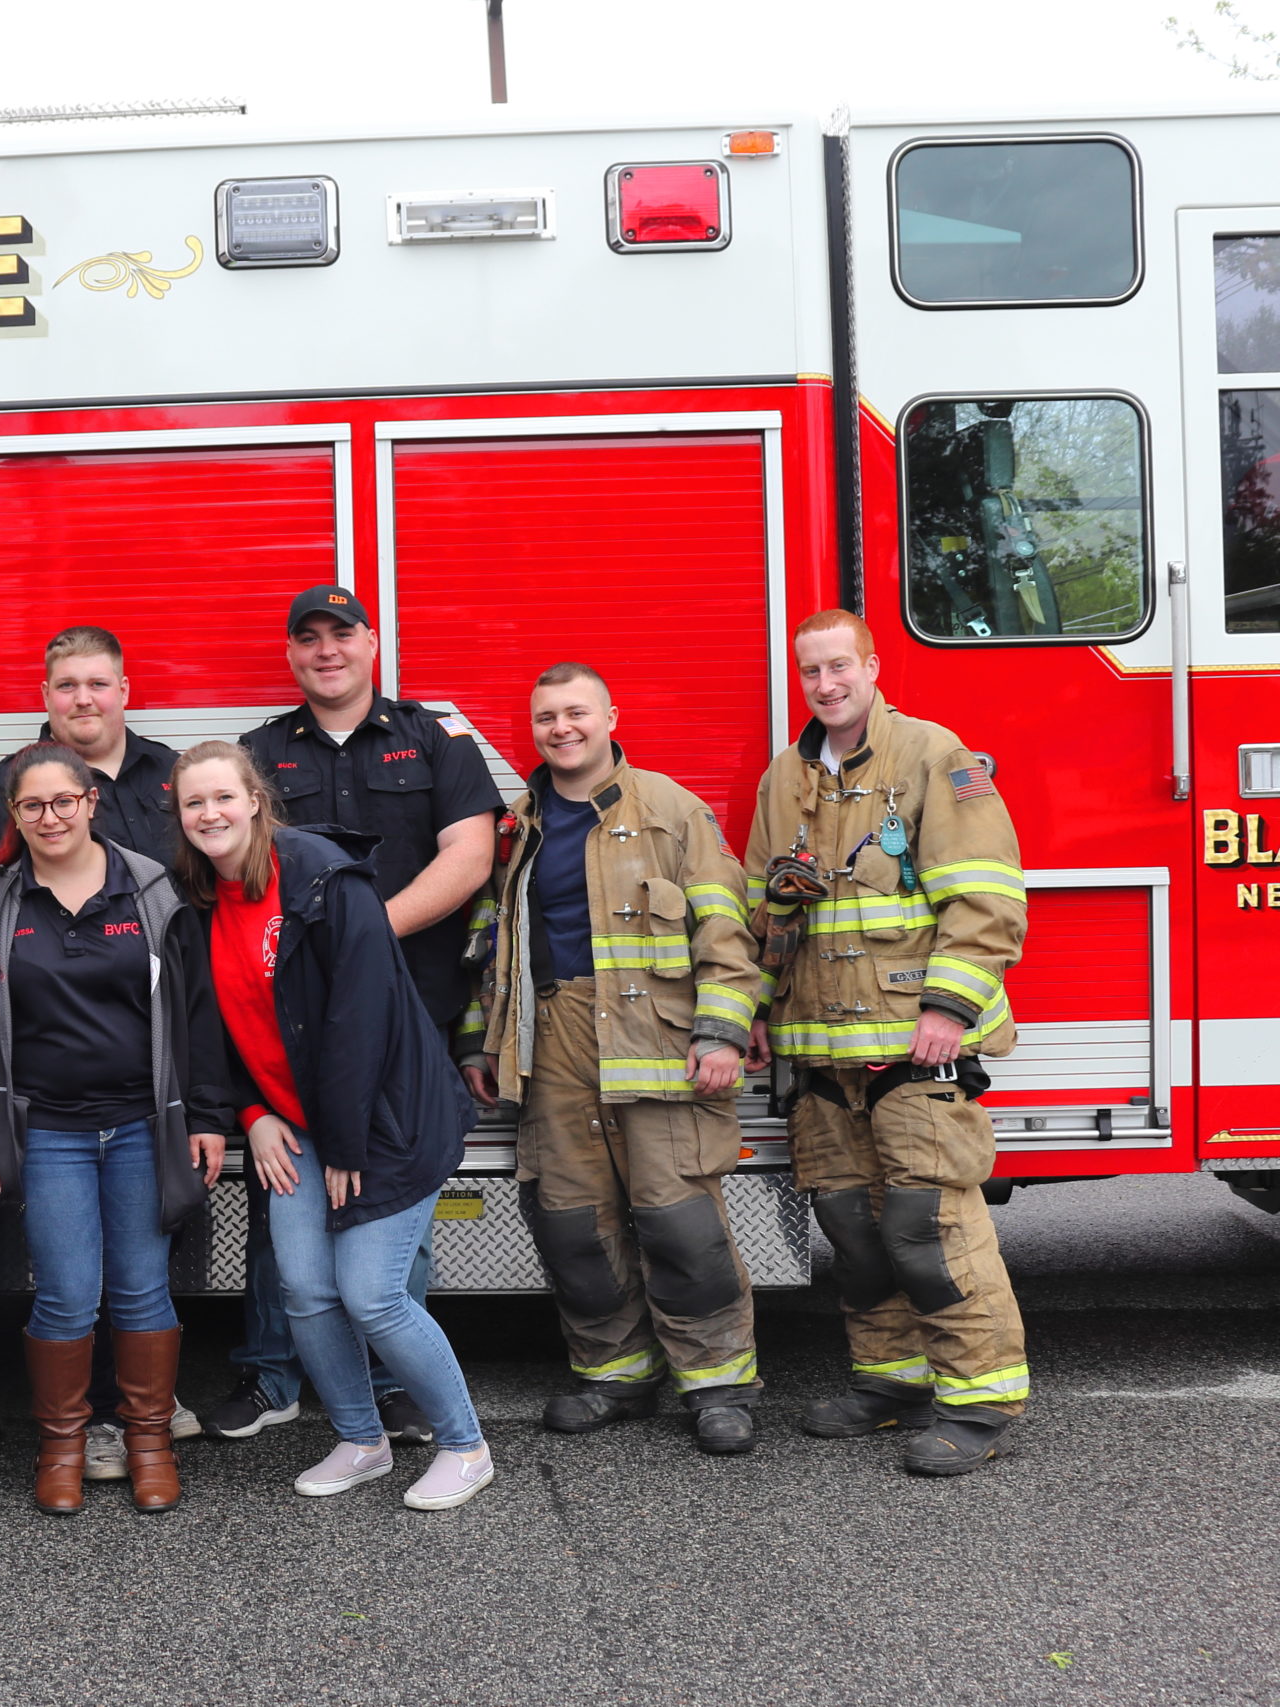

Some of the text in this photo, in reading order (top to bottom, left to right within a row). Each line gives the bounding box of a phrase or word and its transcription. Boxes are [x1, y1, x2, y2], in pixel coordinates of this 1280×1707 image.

[383, 749, 417, 763] BVFC
[1203, 808, 1280, 868] BL
[104, 922, 141, 935] BVFC
